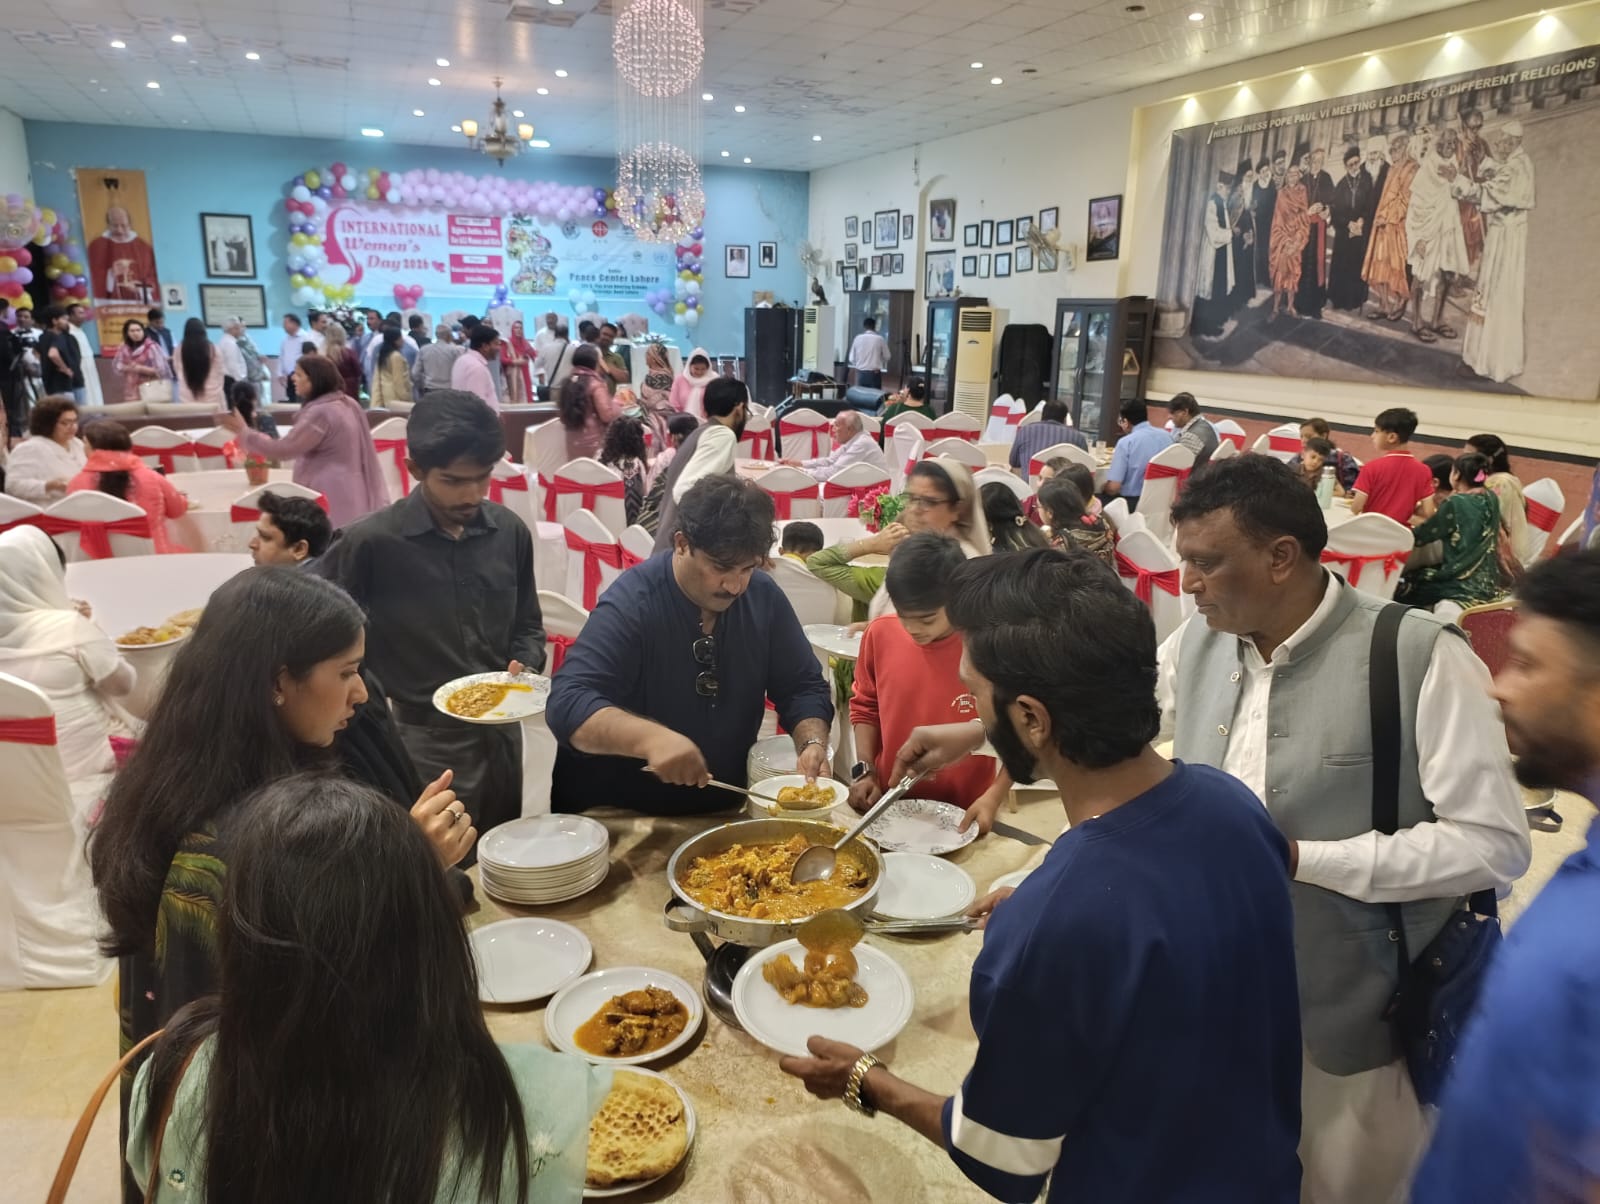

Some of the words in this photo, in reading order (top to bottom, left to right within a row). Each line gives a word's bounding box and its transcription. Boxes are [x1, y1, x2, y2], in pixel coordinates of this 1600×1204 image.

[1213, 128, 1227, 139] HIS
[1227, 121, 1268, 136] HOLINESS
[1269, 117, 1292, 129] POPE
[1294, 113, 1317, 123] PAUL
[1319, 109, 1330, 119] VI
[1331, 101, 1377, 116] MEETING
[1379, 89, 1428, 107] LEADERS
[1431, 88, 1446, 98] OF
[1449, 73, 1518, 95] DIFFERENT
[1520, 57, 1596, 82] RELIGIONS
[341, 220, 442, 237] INTERNATIONAL
[343, 237, 421, 252] Women's
[367, 255, 401, 272] Day
[599, 273, 628, 283] Center
[630, 274, 660, 283] Lahore
